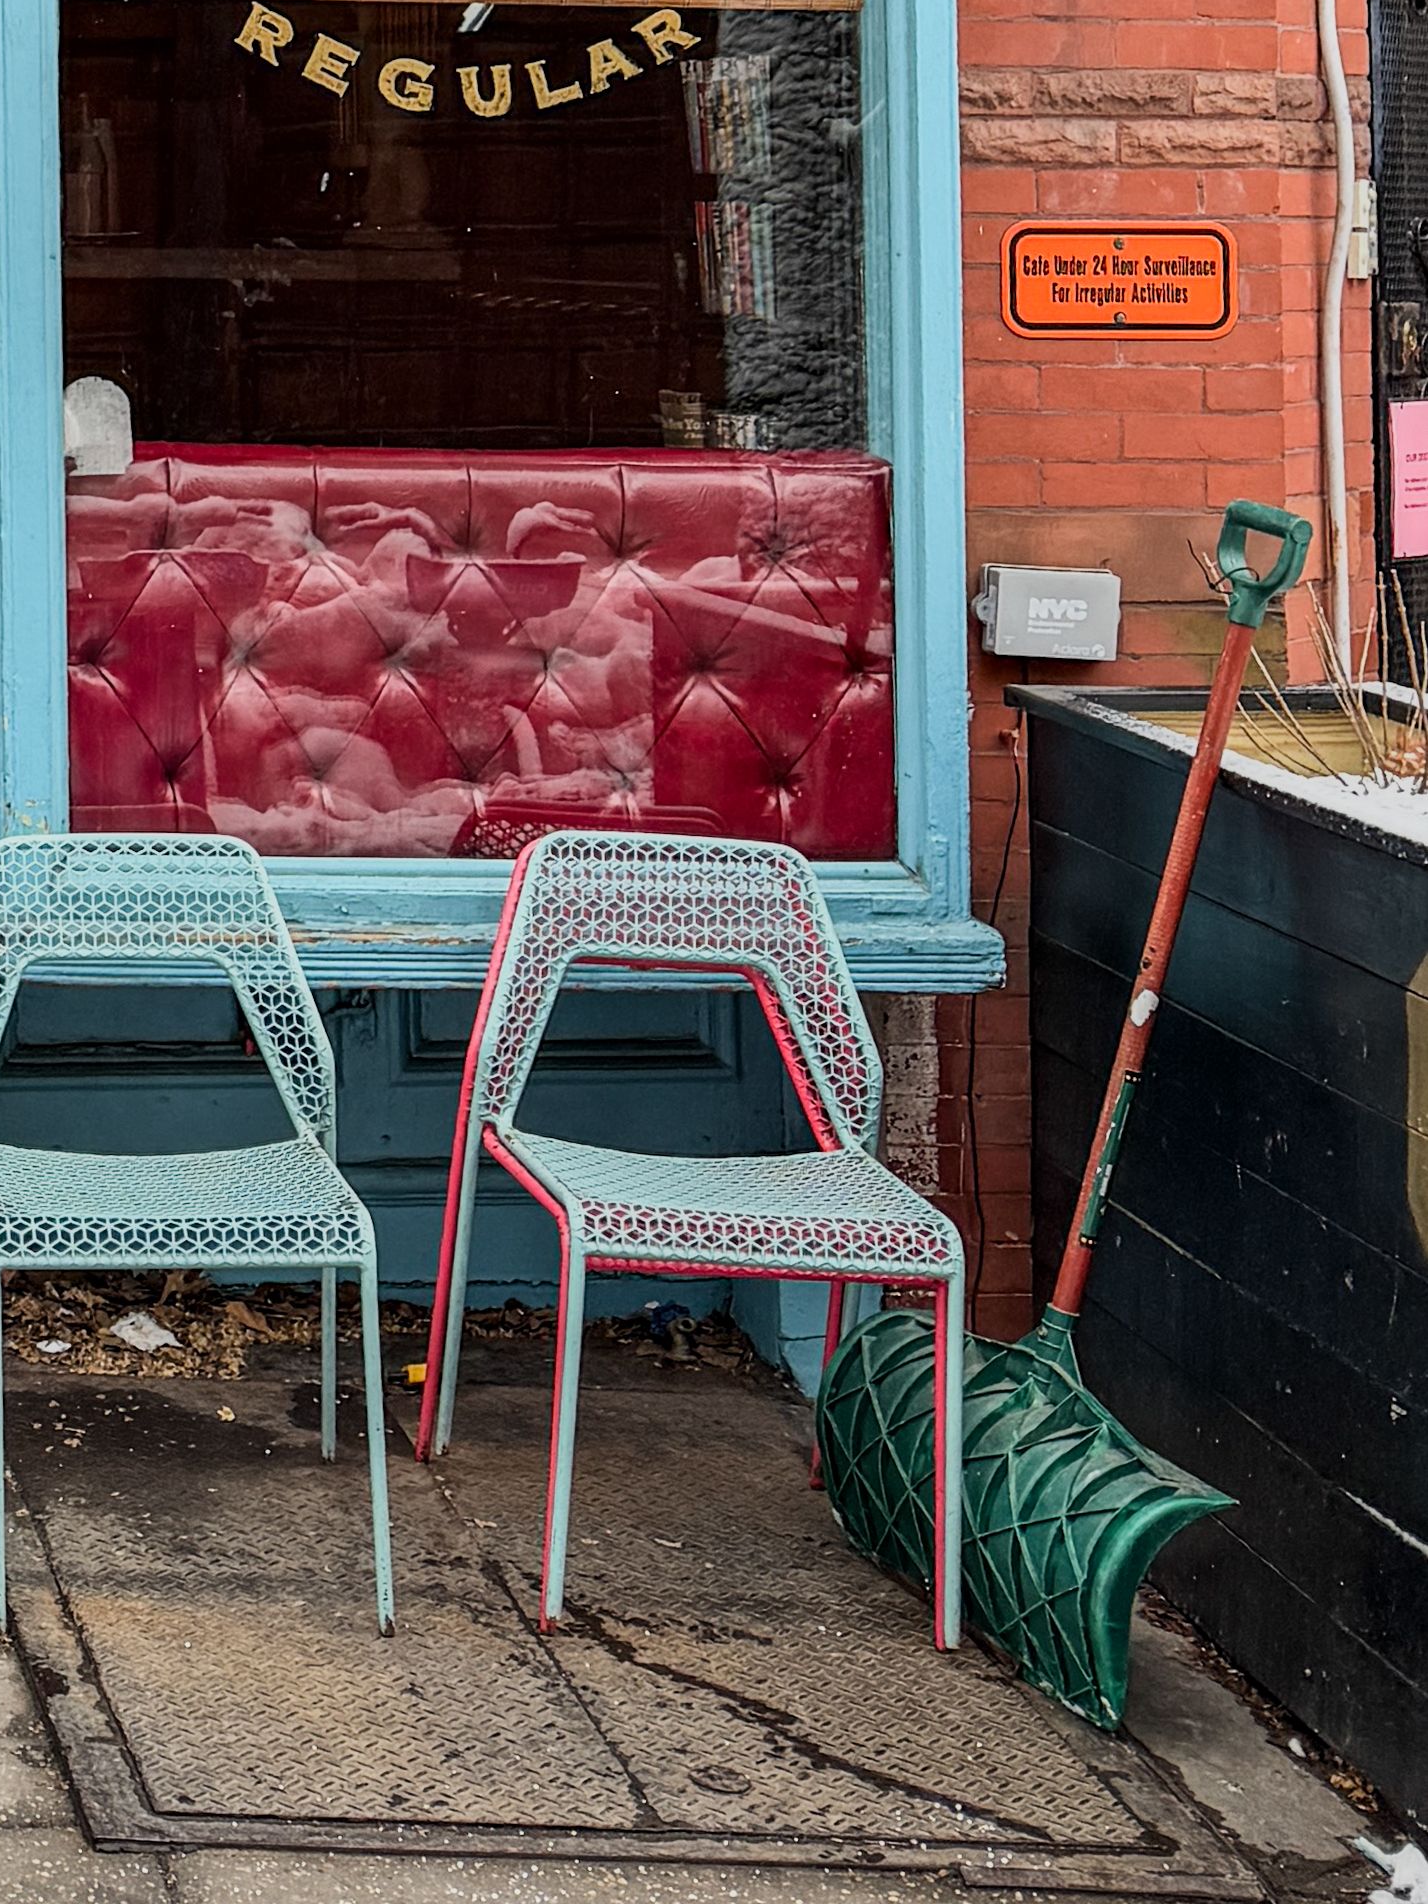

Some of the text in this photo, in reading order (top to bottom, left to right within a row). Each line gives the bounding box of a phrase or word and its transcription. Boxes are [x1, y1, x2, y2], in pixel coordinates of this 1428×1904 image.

[233, 0, 702, 118] REGULAR
[1054, 255, 1088, 276] Under
[1092, 255, 1107, 276] 24
[1111, 255, 1139, 276] Hour
[1144, 255, 1217, 276] Surveillance
[1052, 283, 1189, 307] For Irregular Activities
[1027, 597, 1089, 621] NYC
